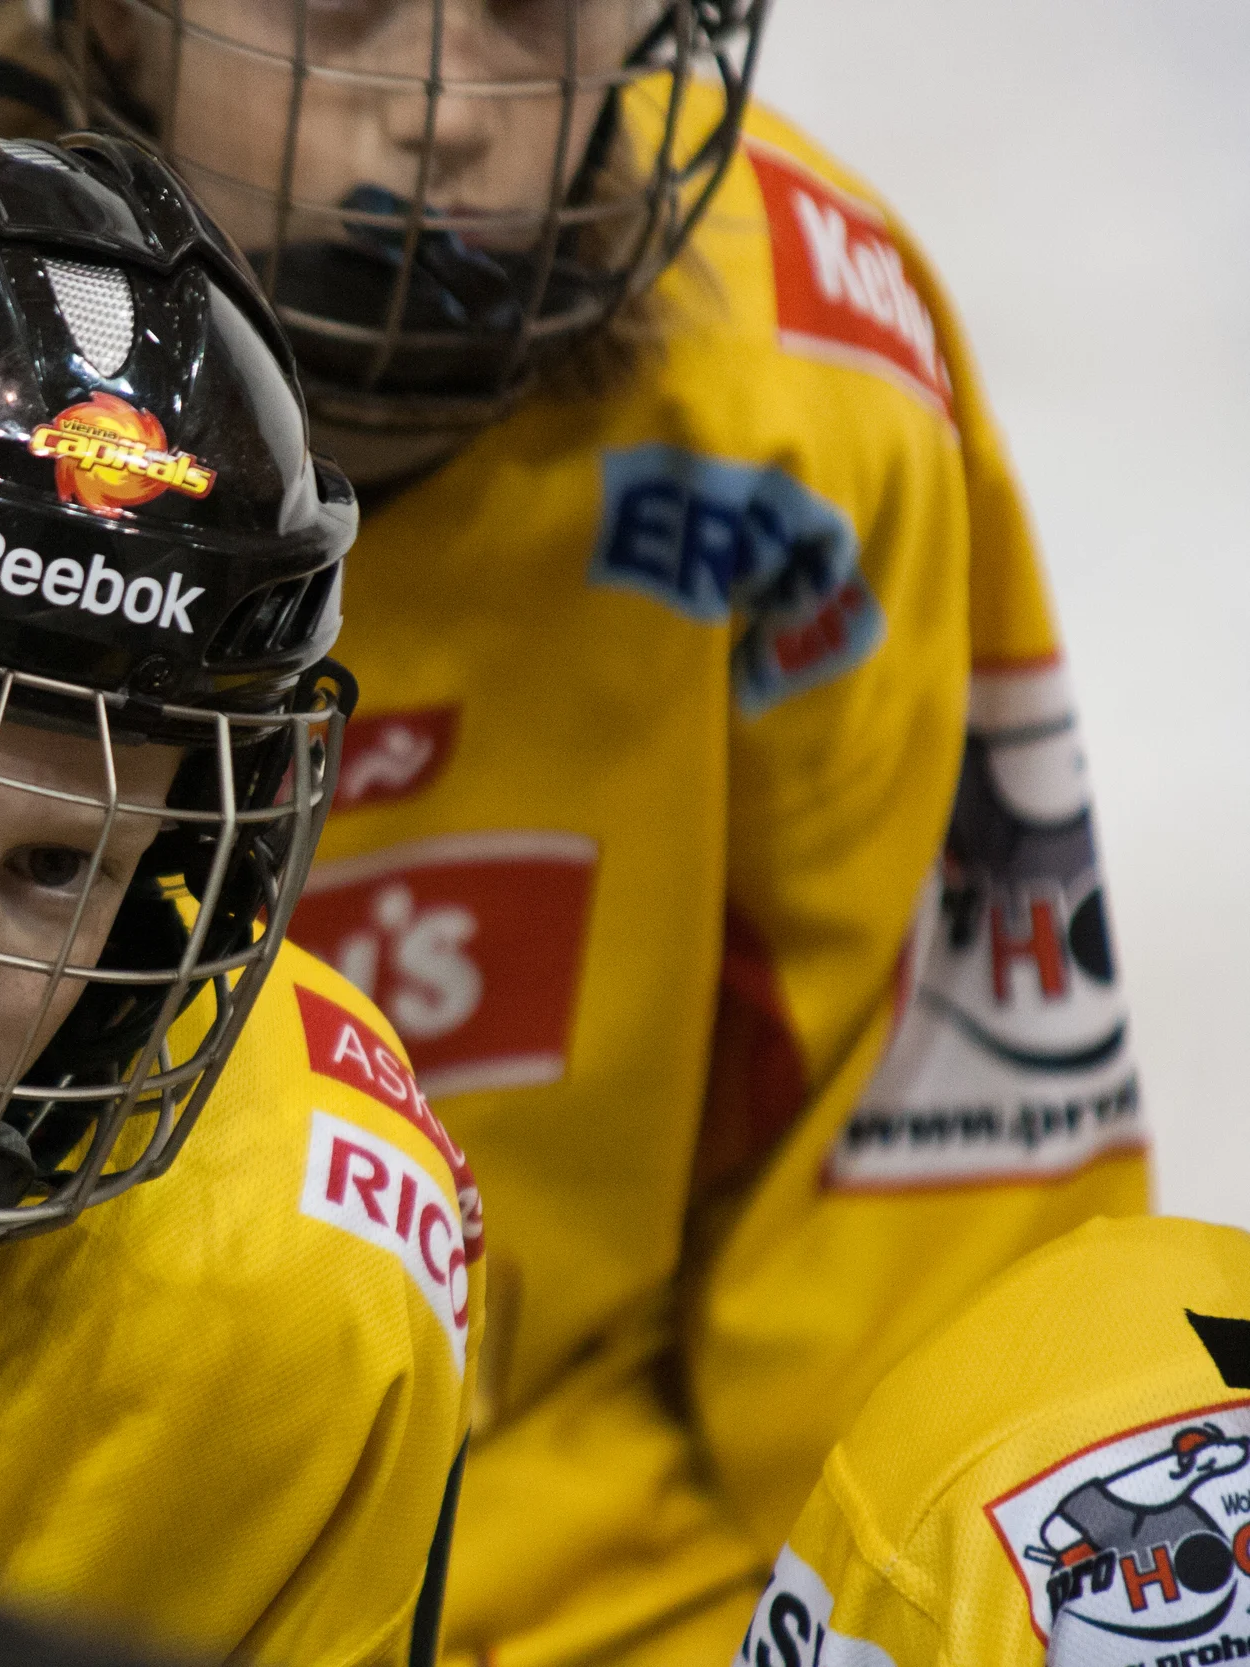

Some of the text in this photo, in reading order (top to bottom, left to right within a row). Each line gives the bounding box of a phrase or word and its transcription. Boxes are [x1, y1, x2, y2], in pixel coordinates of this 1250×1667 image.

[32, 427, 211, 495] capitals
[61, 419, 118, 440] vienna
[325, 1136, 468, 1330] RICO
